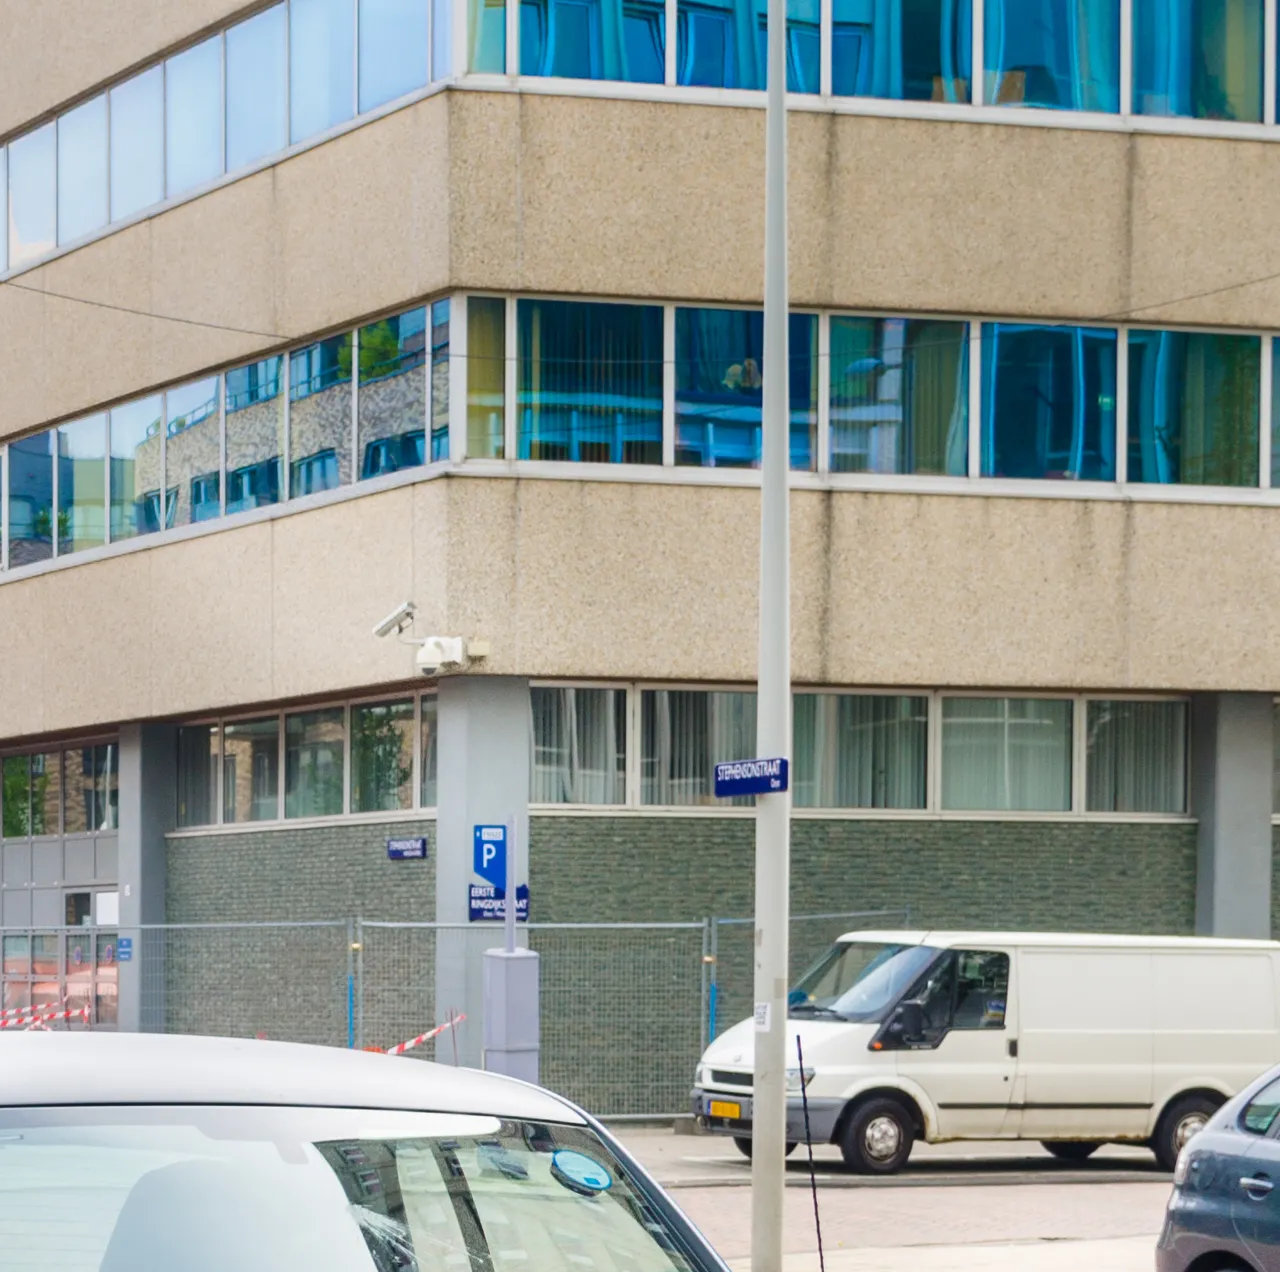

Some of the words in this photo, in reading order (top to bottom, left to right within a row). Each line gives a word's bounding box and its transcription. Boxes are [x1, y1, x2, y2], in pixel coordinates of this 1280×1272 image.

[717, 760, 782, 781] STEPHENSONSTRAAT
[482, 843, 497, 869] P
[471, 887, 495, 898] EERSTE
